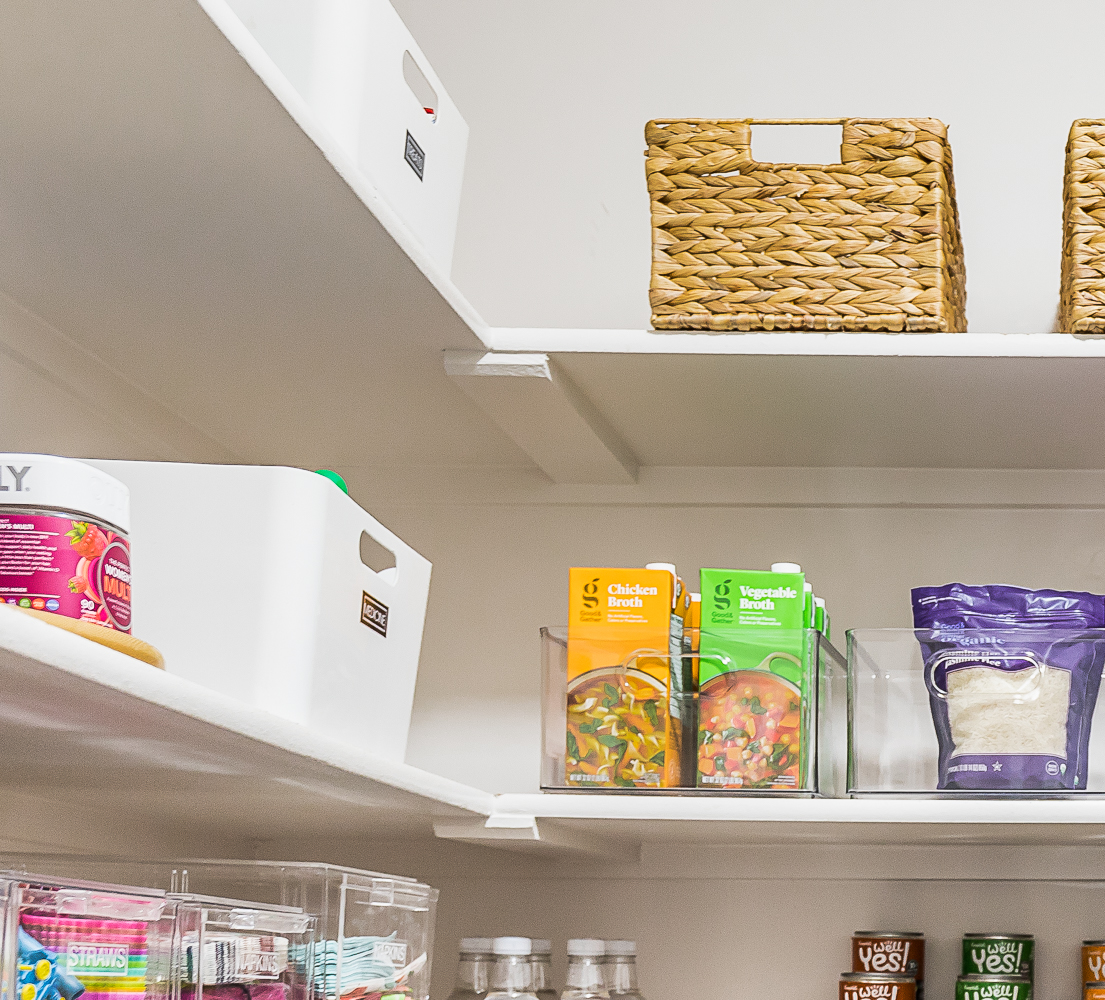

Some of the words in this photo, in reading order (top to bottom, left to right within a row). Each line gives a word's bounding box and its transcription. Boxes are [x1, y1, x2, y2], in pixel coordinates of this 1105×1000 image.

[607, 583, 658, 596] Chicken
[739, 585, 797, 600] Vegetable
[81, 599, 95, 611] 90
[607, 596, 643, 608] Broth
[739, 598, 774, 611] Broth
[873, 940, 905, 953] well
[987, 942, 1018, 954] well
[68, 943, 128, 972] STRAWS
[374, 943, 406, 965] NAPKINS
[858, 941, 910, 973] Yes!
[971, 942, 1023, 973] Yes!
[235, 952, 279, 977] NAPKINS
[858, 985, 891, 998] well
[980, 985, 1013, 998] well
